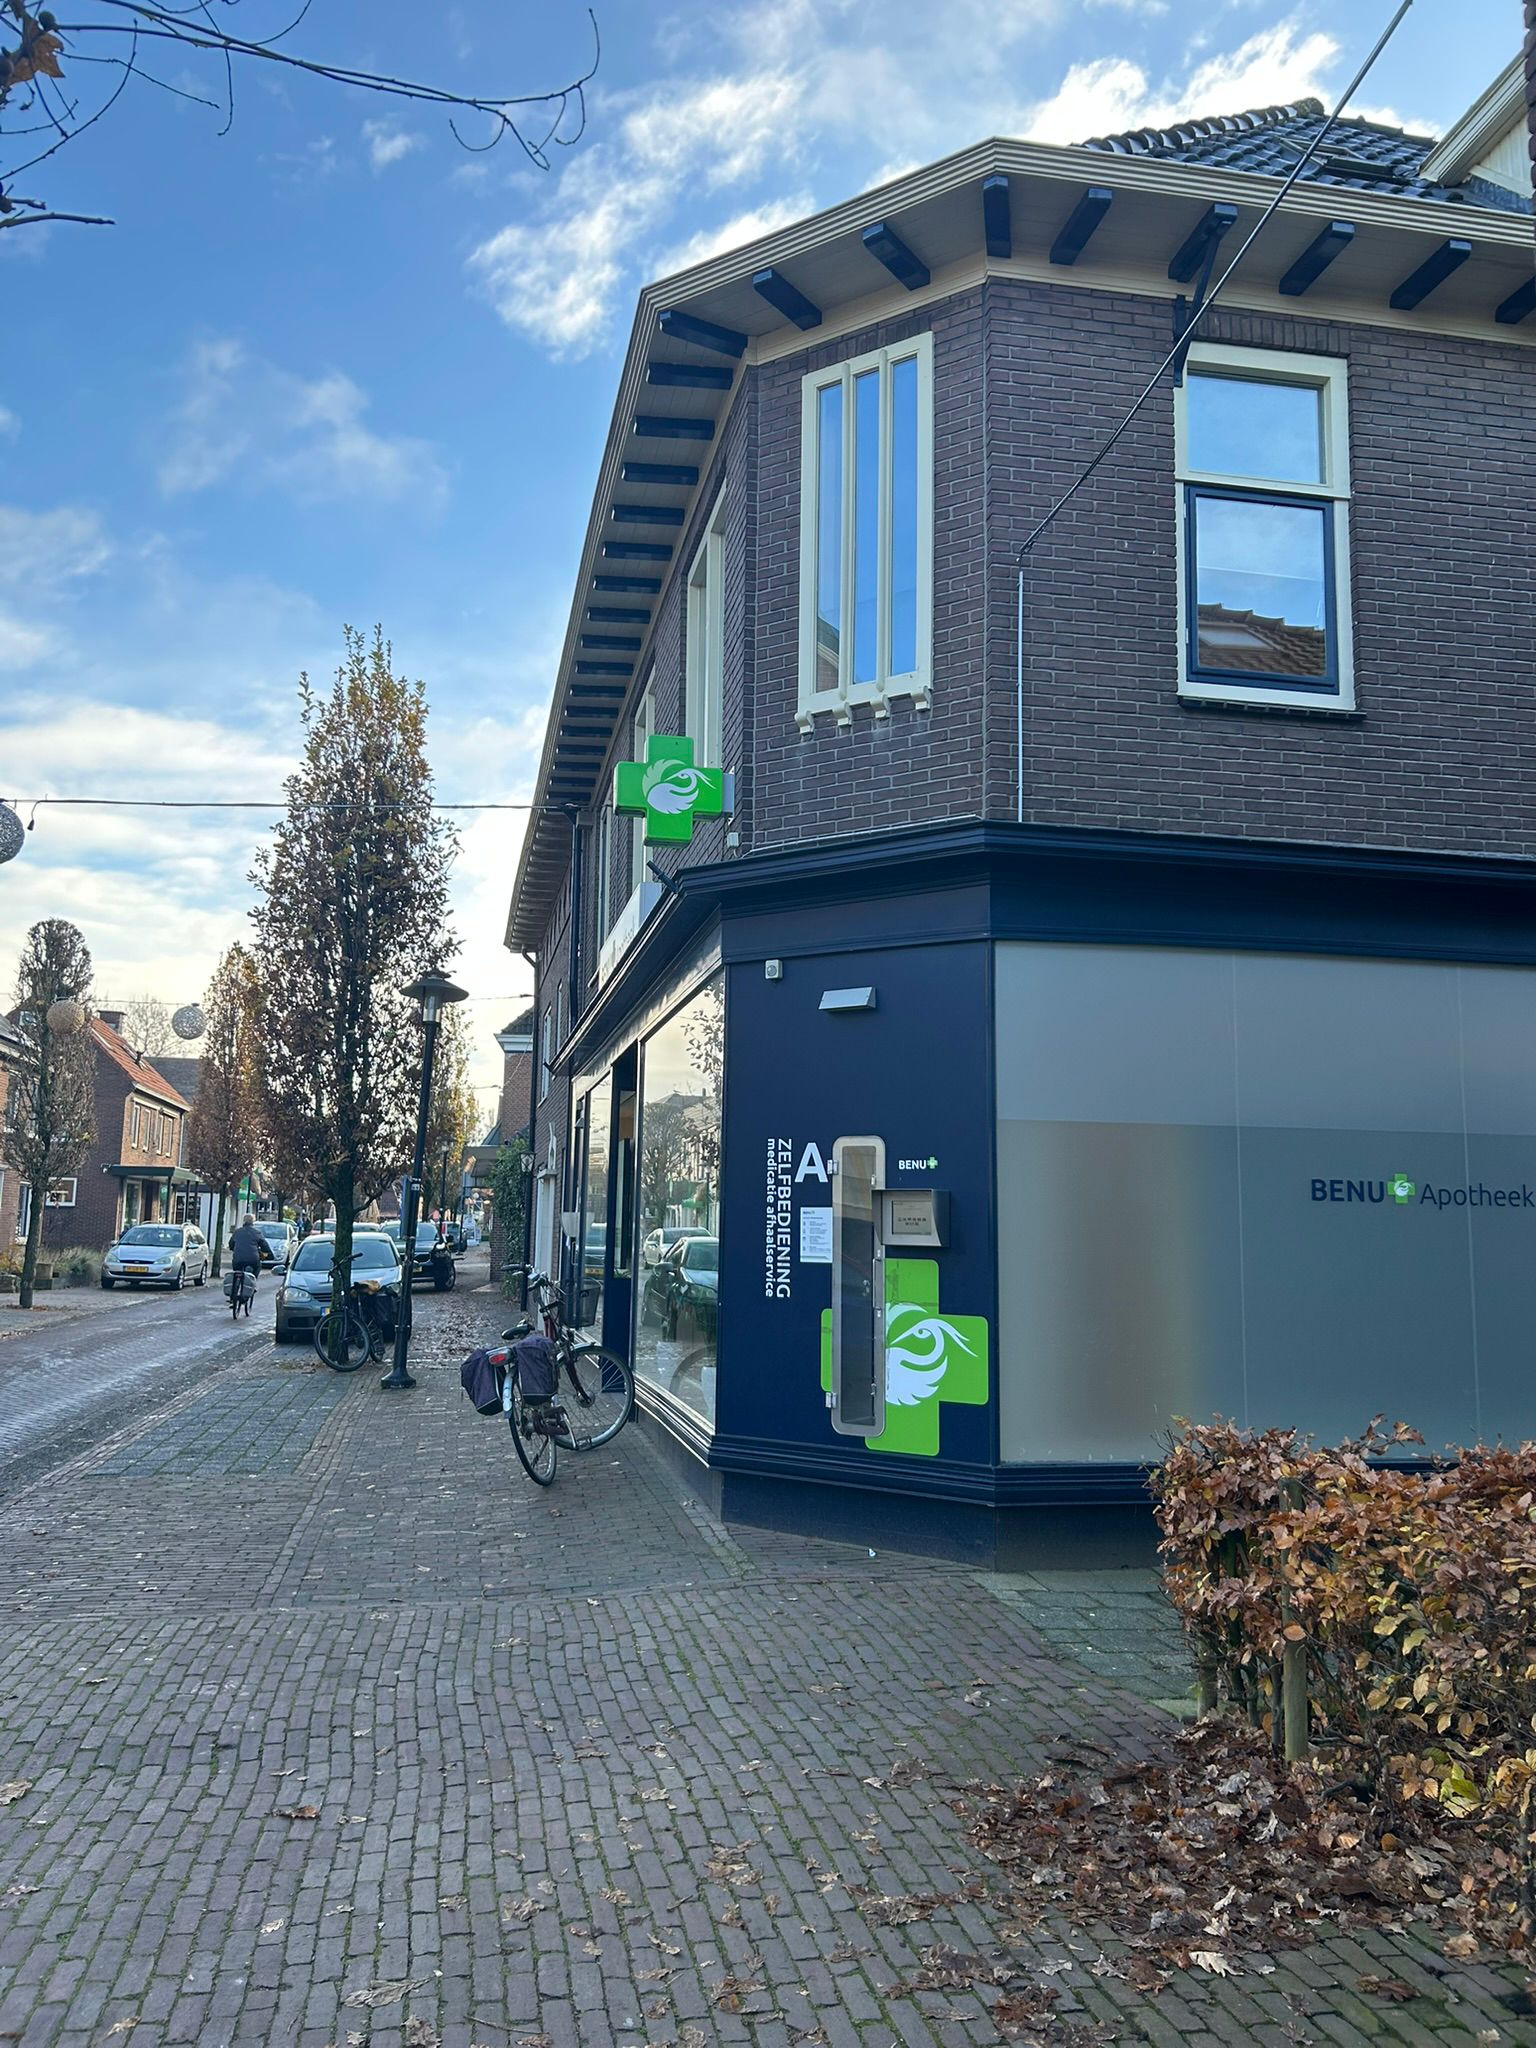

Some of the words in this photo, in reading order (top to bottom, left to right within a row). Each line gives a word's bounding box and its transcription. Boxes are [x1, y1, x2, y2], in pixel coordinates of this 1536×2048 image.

[766, 1138, 777, 1203] medicatie
[794, 1142, 829, 1183] A
[898, 1159, 927, 1170] BENU
[777, 1138, 792, 1298] ZELFBEDIENING
[1311, 1178, 1385, 1204] BENU
[1419, 1183, 1536, 1210] Apotheek
[765, 1206, 776, 1298] afhaalservice
